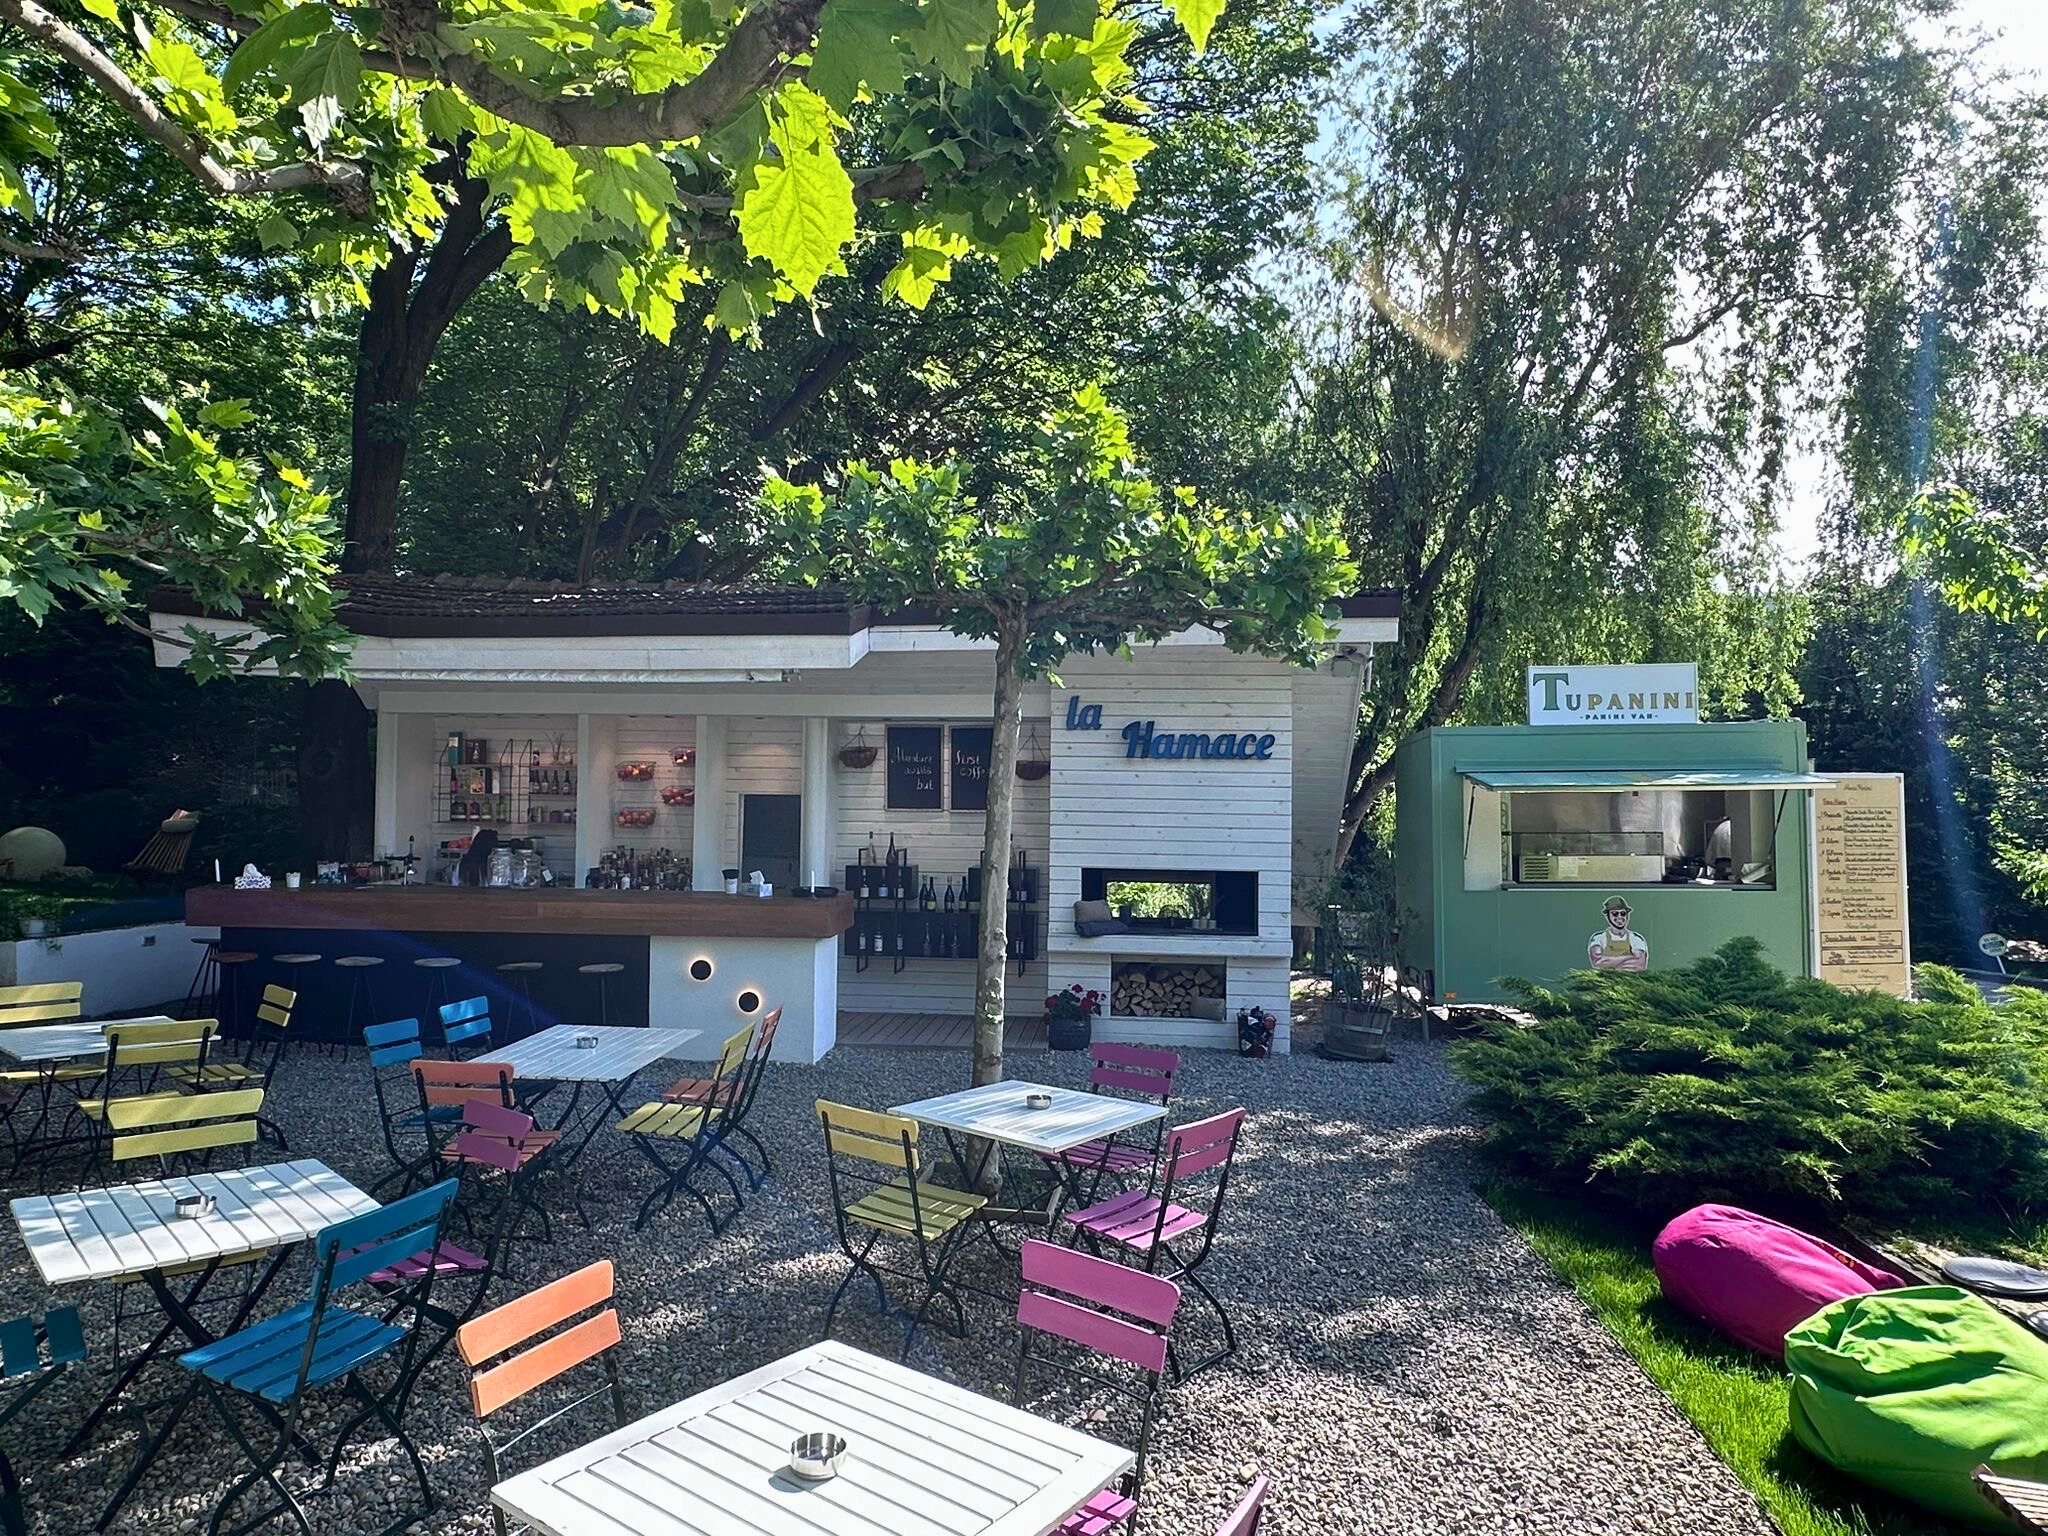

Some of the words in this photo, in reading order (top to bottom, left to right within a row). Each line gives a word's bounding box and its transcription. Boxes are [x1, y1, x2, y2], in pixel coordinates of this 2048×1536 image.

[1532, 673, 1694, 711] TUPANINI
[1065, 695, 1103, 730] la
[1121, 720, 1276, 760] Hamace
